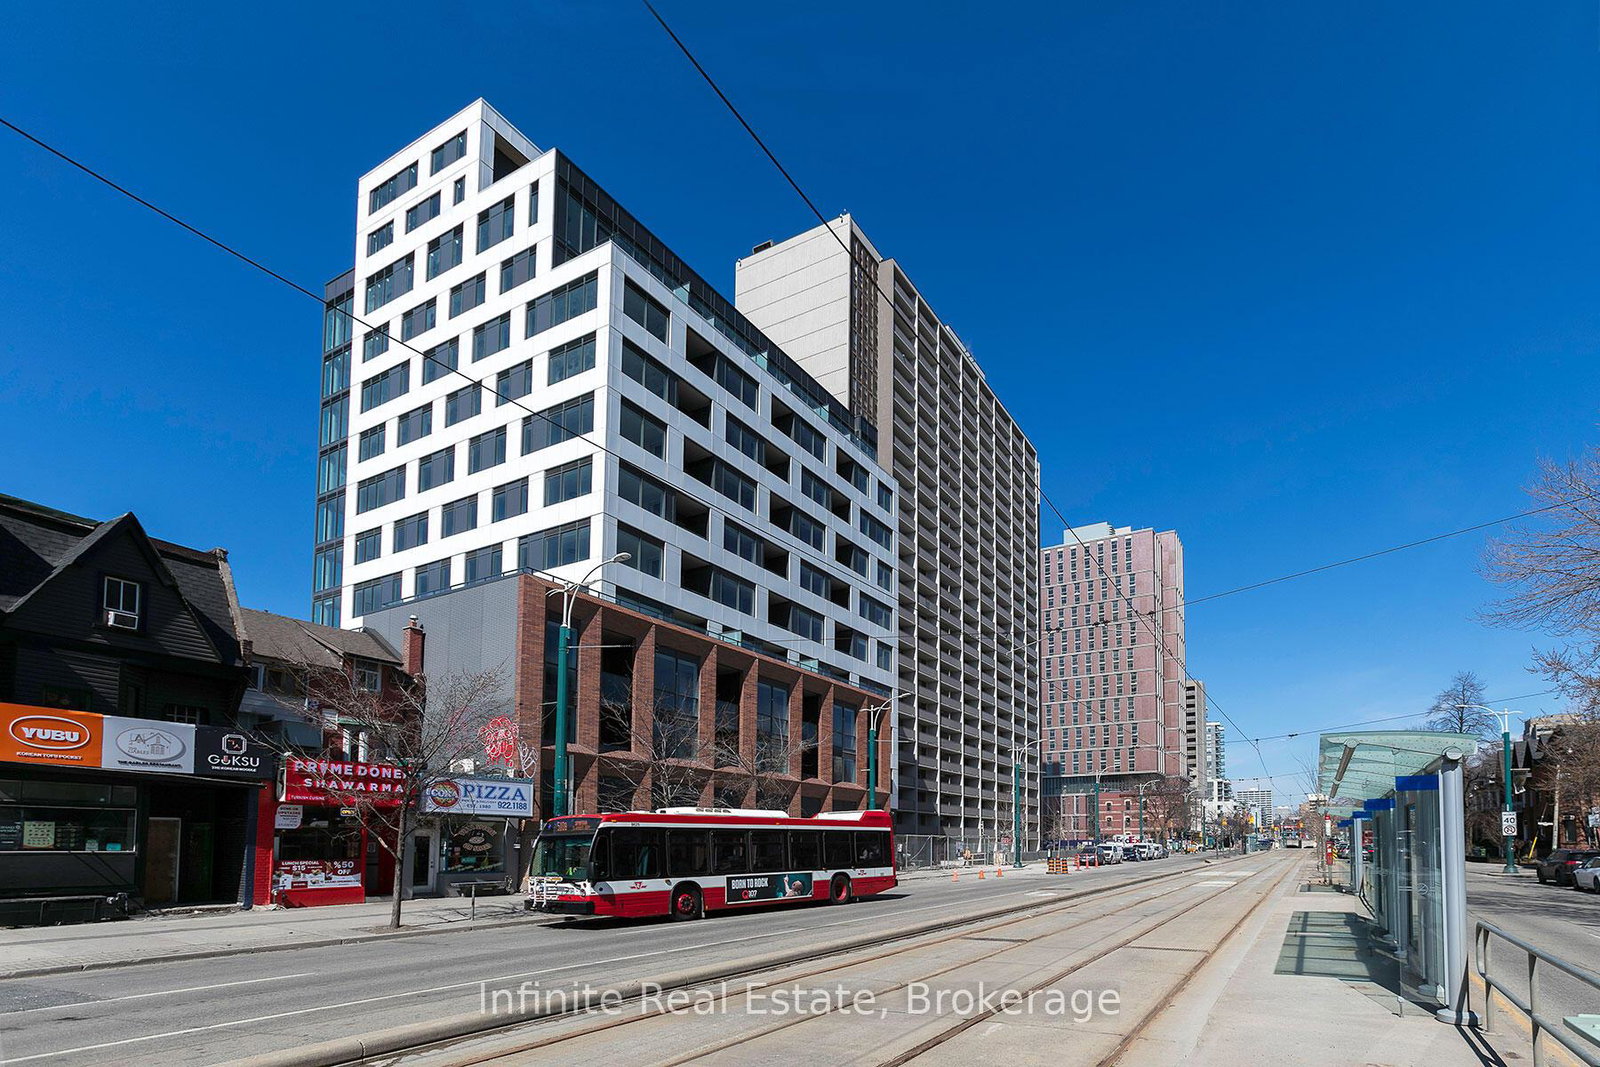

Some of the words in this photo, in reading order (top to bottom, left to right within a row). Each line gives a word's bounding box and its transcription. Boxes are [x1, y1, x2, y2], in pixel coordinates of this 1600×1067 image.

[21, 727, 80, 742] YUBU
[357, 766, 406, 779] DONE
[303, 778, 405, 793] SHAWARMA
[463, 784, 526, 801] PIZZA
[497, 801, 528, 811] 922.1188
[333, 860, 355, 869] %50
[731, 879, 747, 890] BORN
[746, 878, 754, 888] TO
[754, 877, 769, 888] ROCK
[741, 889, 758, 900] Q107
